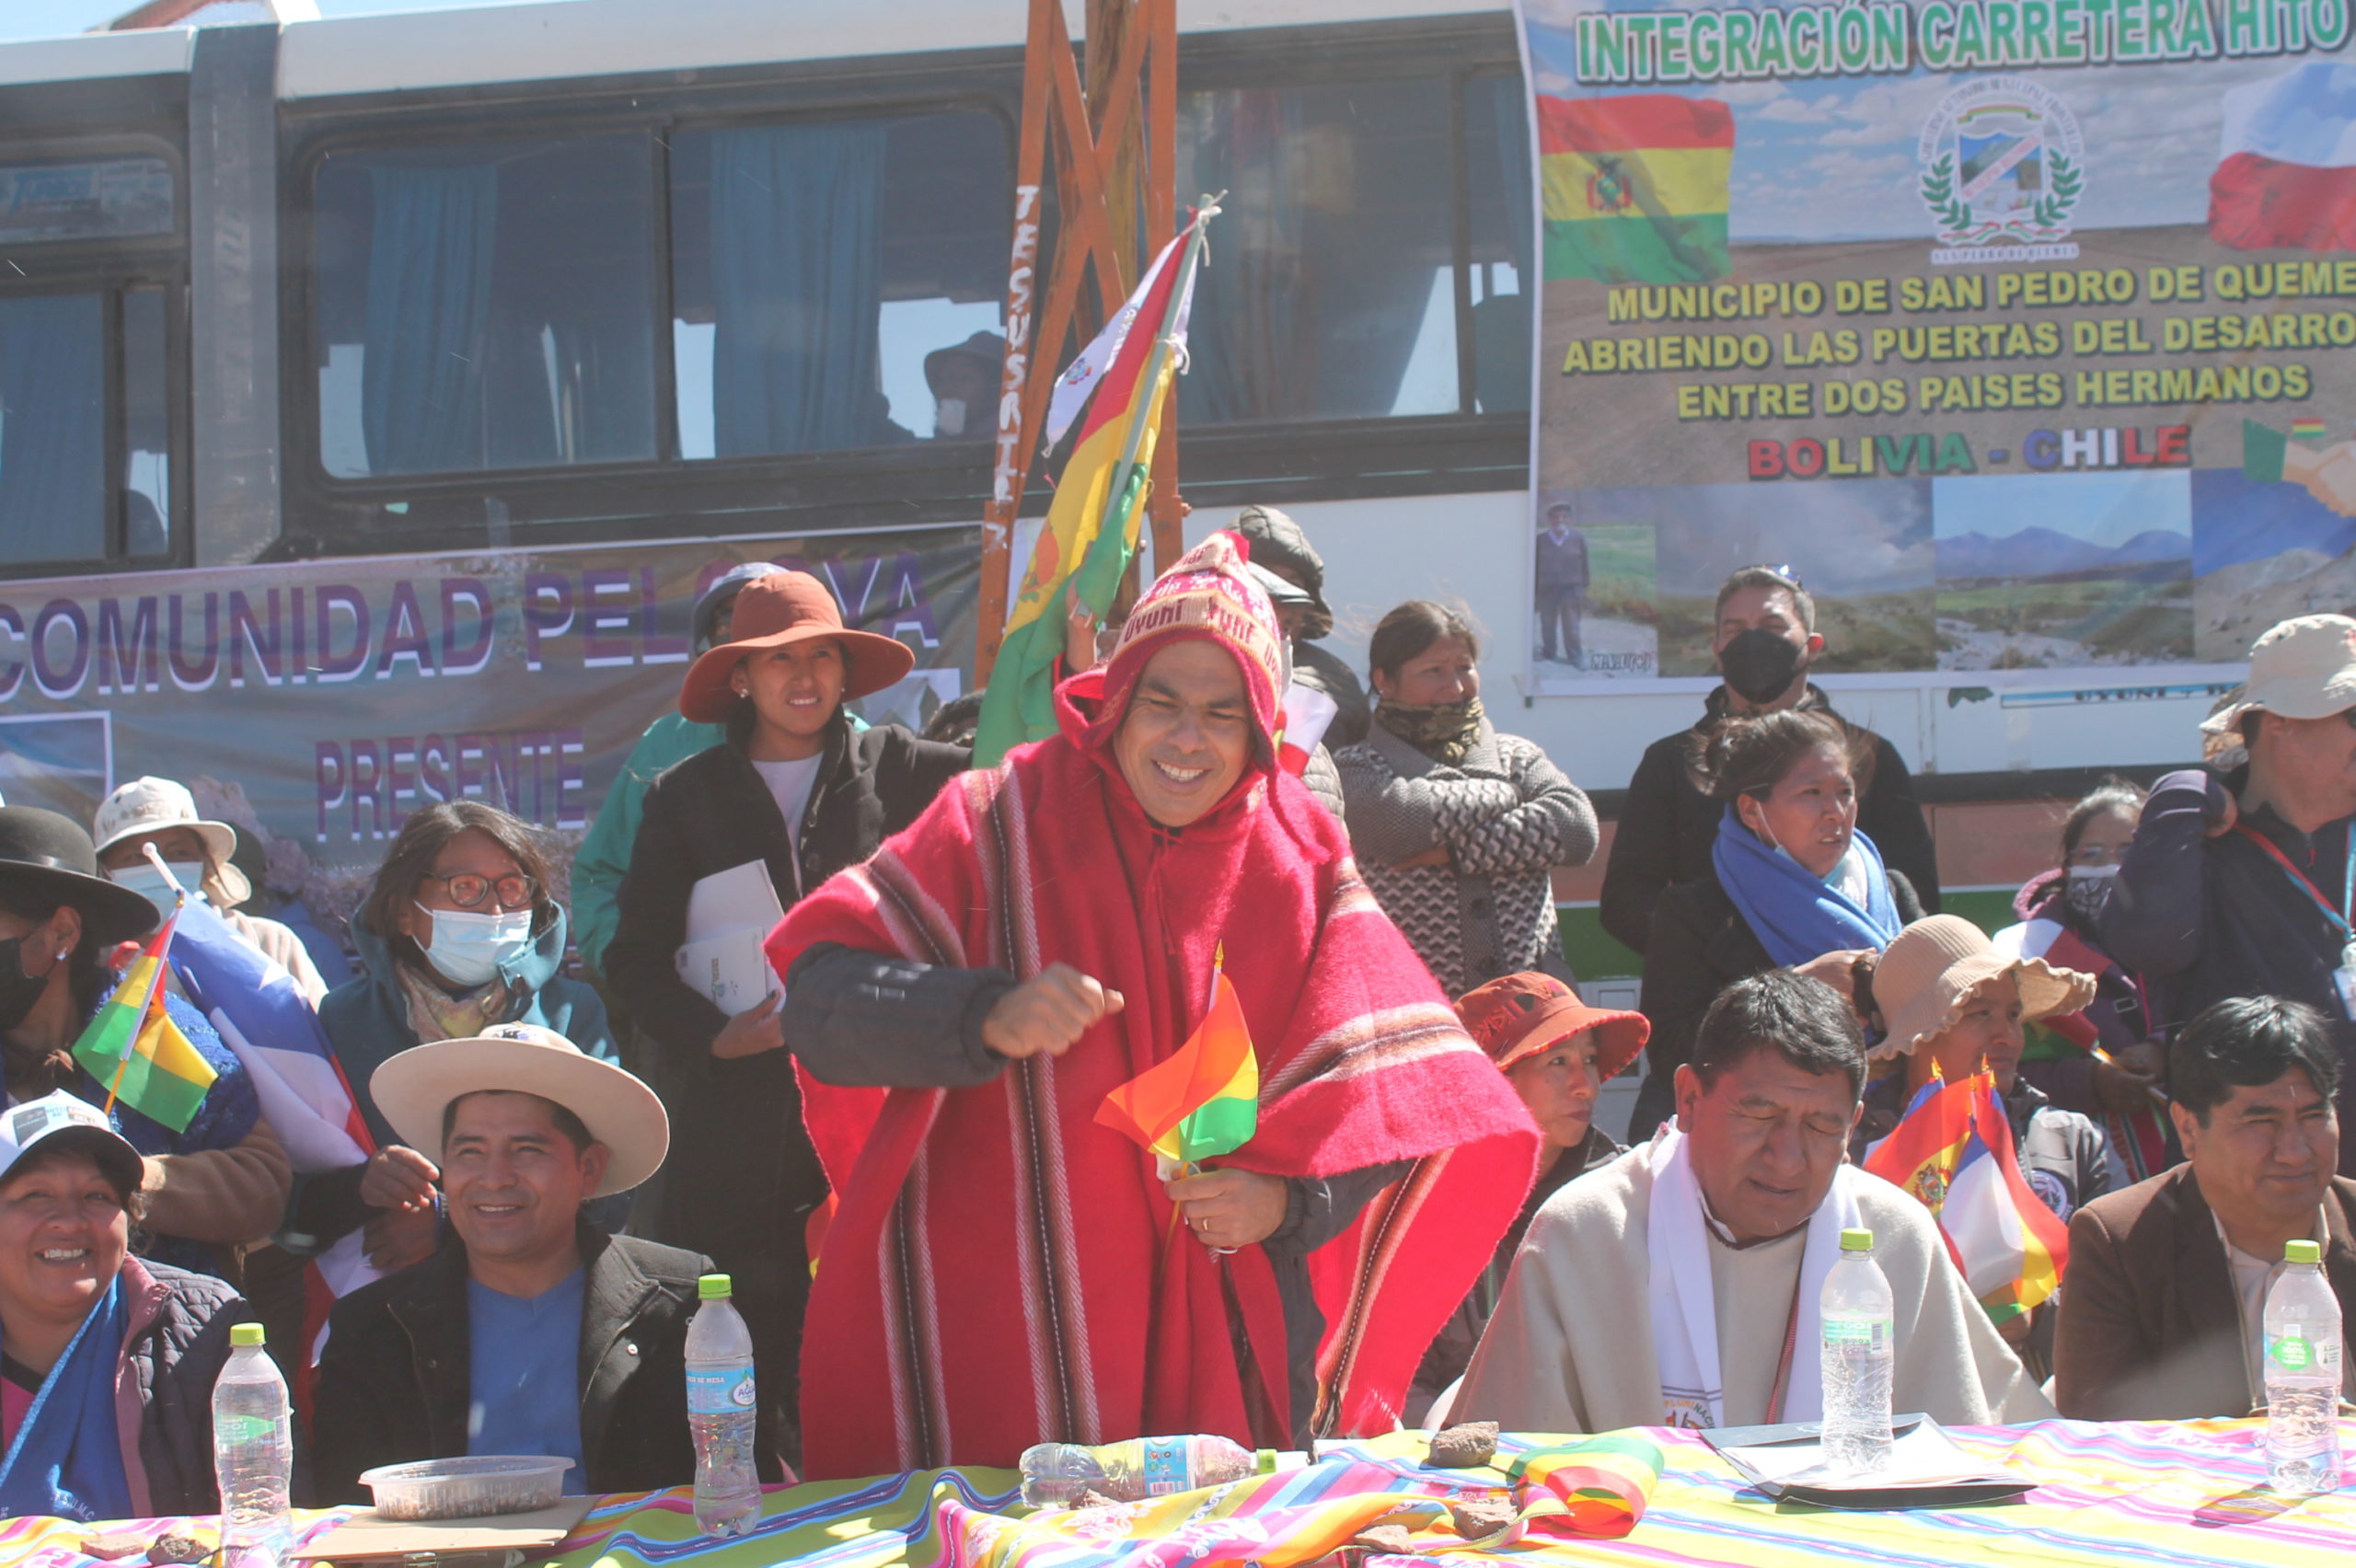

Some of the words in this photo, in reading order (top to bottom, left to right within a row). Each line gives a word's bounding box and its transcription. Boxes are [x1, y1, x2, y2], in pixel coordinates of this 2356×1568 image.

[1918, 0, 2216, 69] CARRETERA
[2223, 0, 2349, 54] HITO
[1608, 281, 1823, 322] MUNICIPIO
[1835, 279, 1888, 313] DE
[1900, 275, 1983, 310] SAN
[1997, 269, 2134, 306] PEDRO
[2149, 265, 2201, 301] DE
[2215, 262, 2356, 301] QUEME
[1562, 333, 1770, 373] ABRIENDO
[1784, 329, 1860, 365] LAS
[1873, 321, 2061, 362] PUERTAS
[2073, 318, 2151, 354] DEL
[2164, 312, 2356, 352] DESARRO
[1678, 383, 1811, 420] ENTRE
[1824, 378, 1907, 414] DOS
[1920, 371, 2062, 409] PAISES
[2076, 365, 2310, 405] HERMANOS
[1748, 432, 1976, 478] BOLIVIA
[2023, 426, 2192, 467] CHILE
[525, 550, 940, 672] PELYA
[316, 729, 586, 842] PRESENTE
